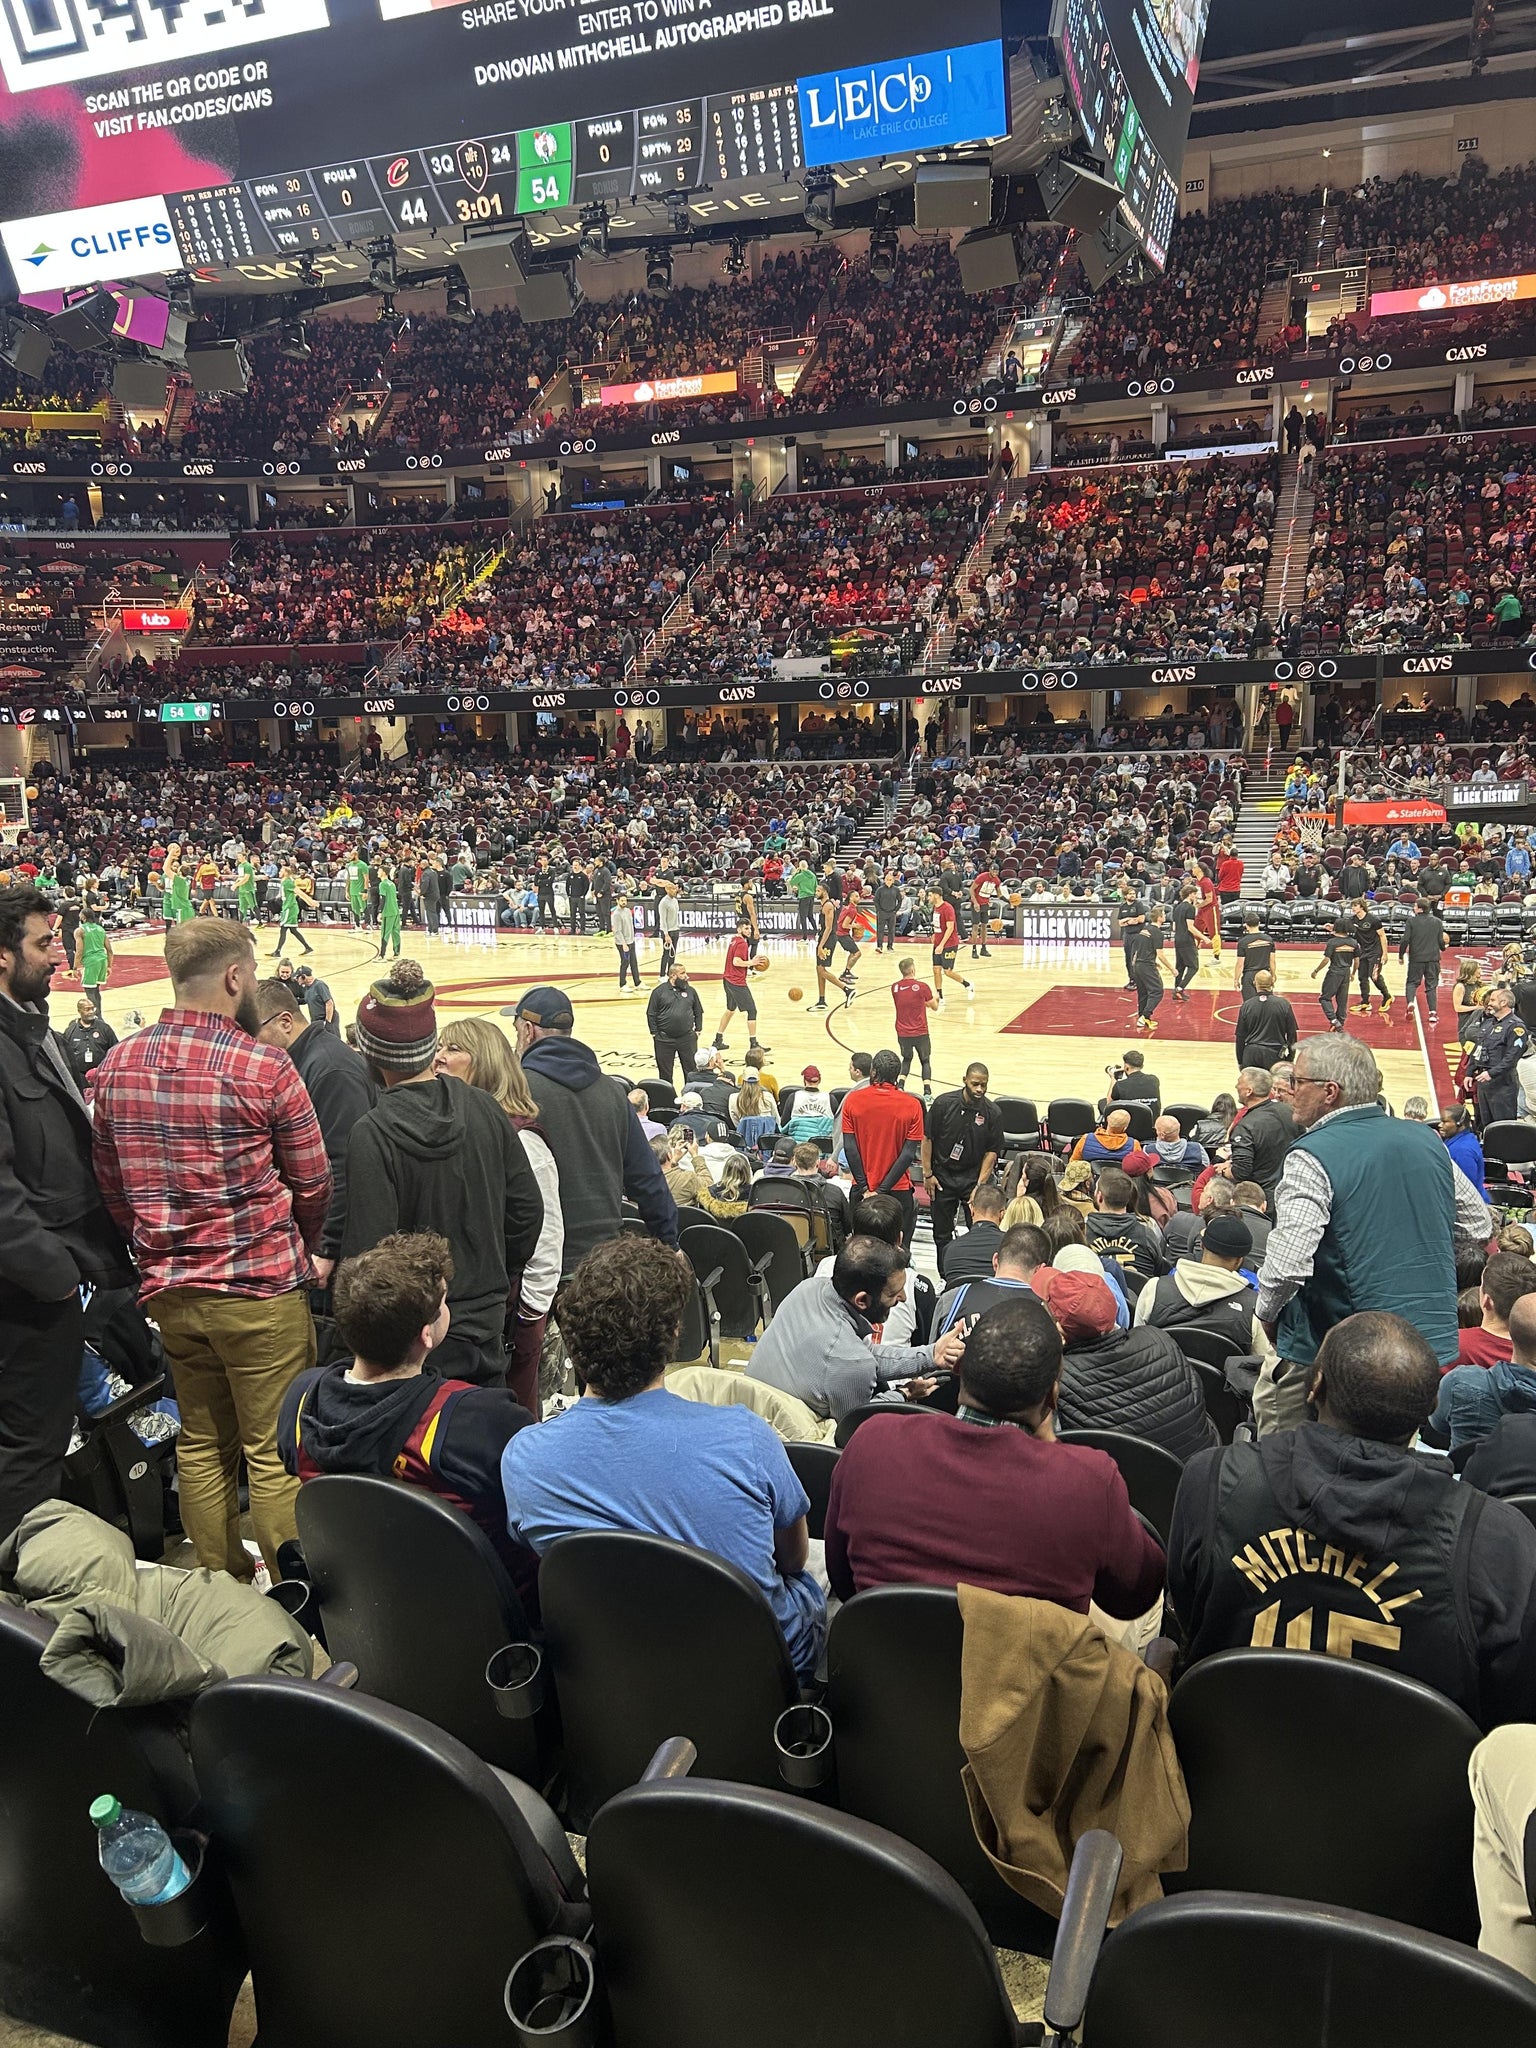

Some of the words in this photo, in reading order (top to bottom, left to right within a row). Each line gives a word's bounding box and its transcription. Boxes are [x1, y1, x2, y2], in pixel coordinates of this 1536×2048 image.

[461, 0, 518, 29] SHARE
[521, 0, 566, 17] YOUR
[578, 6, 632, 35] ENTER
[633, 1, 658, 23] TO
[662, 0, 695, 18] WIN
[699, 0, 712, 9] A
[474, 52, 554, 86] DONOVAN
[557, 32, 652, 70] MITHCHELL
[655, 4, 783, 50] AUTOGRAPHED
[787, 0, 834, 22] BALL
[85, 88, 129, 113] SCAN
[131, 82, 164, 104] THE
[166, 76, 191, 97] QR
[194, 66, 239, 92] CODE
[242, 61, 268, 82] OR
[731, 94, 746, 105] PTS
[750, 91, 765, 101] REB
[768, 88, 782, 98] AST
[784, 84, 798, 94] FLS
[94, 115, 133, 138] VISIT
[137, 88, 273, 130] FAN.CODES/CAVS
[676, 108, 692, 124] 35
[713, 112, 720, 124] 0
[731, 107, 745, 122] 10
[752, 105, 760, 118] 3
[770, 101, 778, 114] 3
[786, 98, 795, 111] 0
[587, 120, 623, 138] FOULS
[715, 125, 723, 138] 4
[735, 122, 743, 135] 0
[772, 115, 778, 129] 1
[789, 112, 796, 126] 2
[853, 124, 878, 140] LAKE
[881, 121, 901, 136] ERIE
[904, 113, 949, 131] COLLEGE
[676, 137, 692, 153] 29
[716, 140, 723, 152] 7
[735, 135, 748, 149] 16
[773, 130, 781, 143] 2
[790, 127, 798, 140] 2
[1458, 139, 1479, 151] 211
[491, 145, 511, 164] 24
[599, 144, 610, 162] 0
[718, 153, 726, 165] 8
[739, 149, 746, 162] 4
[757, 146, 765, 159] 4
[775, 143, 782, 157] 1
[792, 141, 798, 154] 1
[431, 156, 455, 175] 3Q
[466, 165, 483, 178] -10
[676, 167, 685, 181] 5
[720, 167, 728, 179] 9
[741, 163, 748, 176] 3
[759, 160, 767, 173] 3
[777, 157, 783, 171] 1
[793, 154, 801, 168] 0
[323, 168, 357, 184] FOULS
[214, 188, 227, 198] AST
[286, 179, 300, 193] 30
[531, 176, 560, 204] 54
[592, 180, 619, 195] BONUS
[1186, 180, 1204, 192] 210
[341, 189, 352, 206] 0
[175, 208, 181, 218] 1
[187, 205, 195, 216] 0
[203, 202, 211, 213] 5
[218, 200, 226, 211] 0
[233, 197, 241, 208] 2
[296, 203, 310, 217] 16
[400, 198, 428, 225] 44
[456, 194, 503, 221] 3:01
[178, 219, 185, 229] 5
[190, 217, 198, 228] 9
[207, 214, 213, 225] 1
[222, 211, 229, 222] 1
[236, 209, 244, 220] 0
[348, 220, 375, 234] BONUS
[70, 223, 172, 257] CLIFFS
[179, 231, 191, 242] 10
[210, 226, 217, 237] 1
[225, 223, 233, 234] 2
[239, 221, 247, 232] 2
[311, 227, 320, 240] 5
[182, 242, 193, 253] 31
[195, 240, 208, 251] 10
[211, 237, 223, 249] 13
[228, 235, 235, 246] 1
[243, 233, 250, 244] 2
[186, 254, 198, 265] 45
[199, 251, 211, 264] 13
[231, 247, 239, 258] 3
[246, 245, 254, 256] 2
[1299, 275, 1313, 284] 210
[1344, 270, 1358, 278] 211
[1449, 279, 1518, 296] ForeFront
[1450, 290, 1517, 305] TECHNOLOGY
[1444, 343, 1488, 362] CAVS
[1235, 366, 1275, 385] CAVS
[655, 378, 702, 393] ForeFront
[1041, 388, 1077, 405] CAVS
[651, 430, 681, 445] CAVS
[484, 448, 512, 462] CAVS
[13, 461, 46, 475] CAVS
[183, 463, 214, 476] CAVS
[337, 459, 366, 472] CAVS
[55, 542, 75, 550] M104
[141, 613, 170, 626] fubo
[1402, 655, 1453, 674] CAVS
[1151, 666, 1196, 683] CAVS
[719, 685, 757, 702] CAVS
[921, 676, 963, 694] CAVS
[363, 698, 395, 713] CAVS
[532, 693, 566, 709] CAVS
[43, 709, 60, 721] 44
[73, 711, 86, 719] 3Q
[104, 710, 128, 719] 3:01
[144, 709, 157, 718] 24
[170, 707, 184, 718] 54
[1453, 791, 1481, 804] BLACK
[1482, 789, 1520, 803] HISTORY
[1451, 894, 1460, 902] G
[456, 909, 497, 926] HISTORY
[1023, 909, 1090, 917] ELEVATED
[1096, 909, 1114, 917] BY
[1023, 917, 1066, 939] BLACK
[1067, 917, 1112, 939] VOICES
[798, 1104, 826, 1114] MITCHELL
[133, 1464, 143, 1476] 10
[1231, 1527, 1424, 1624] MITCHELL
